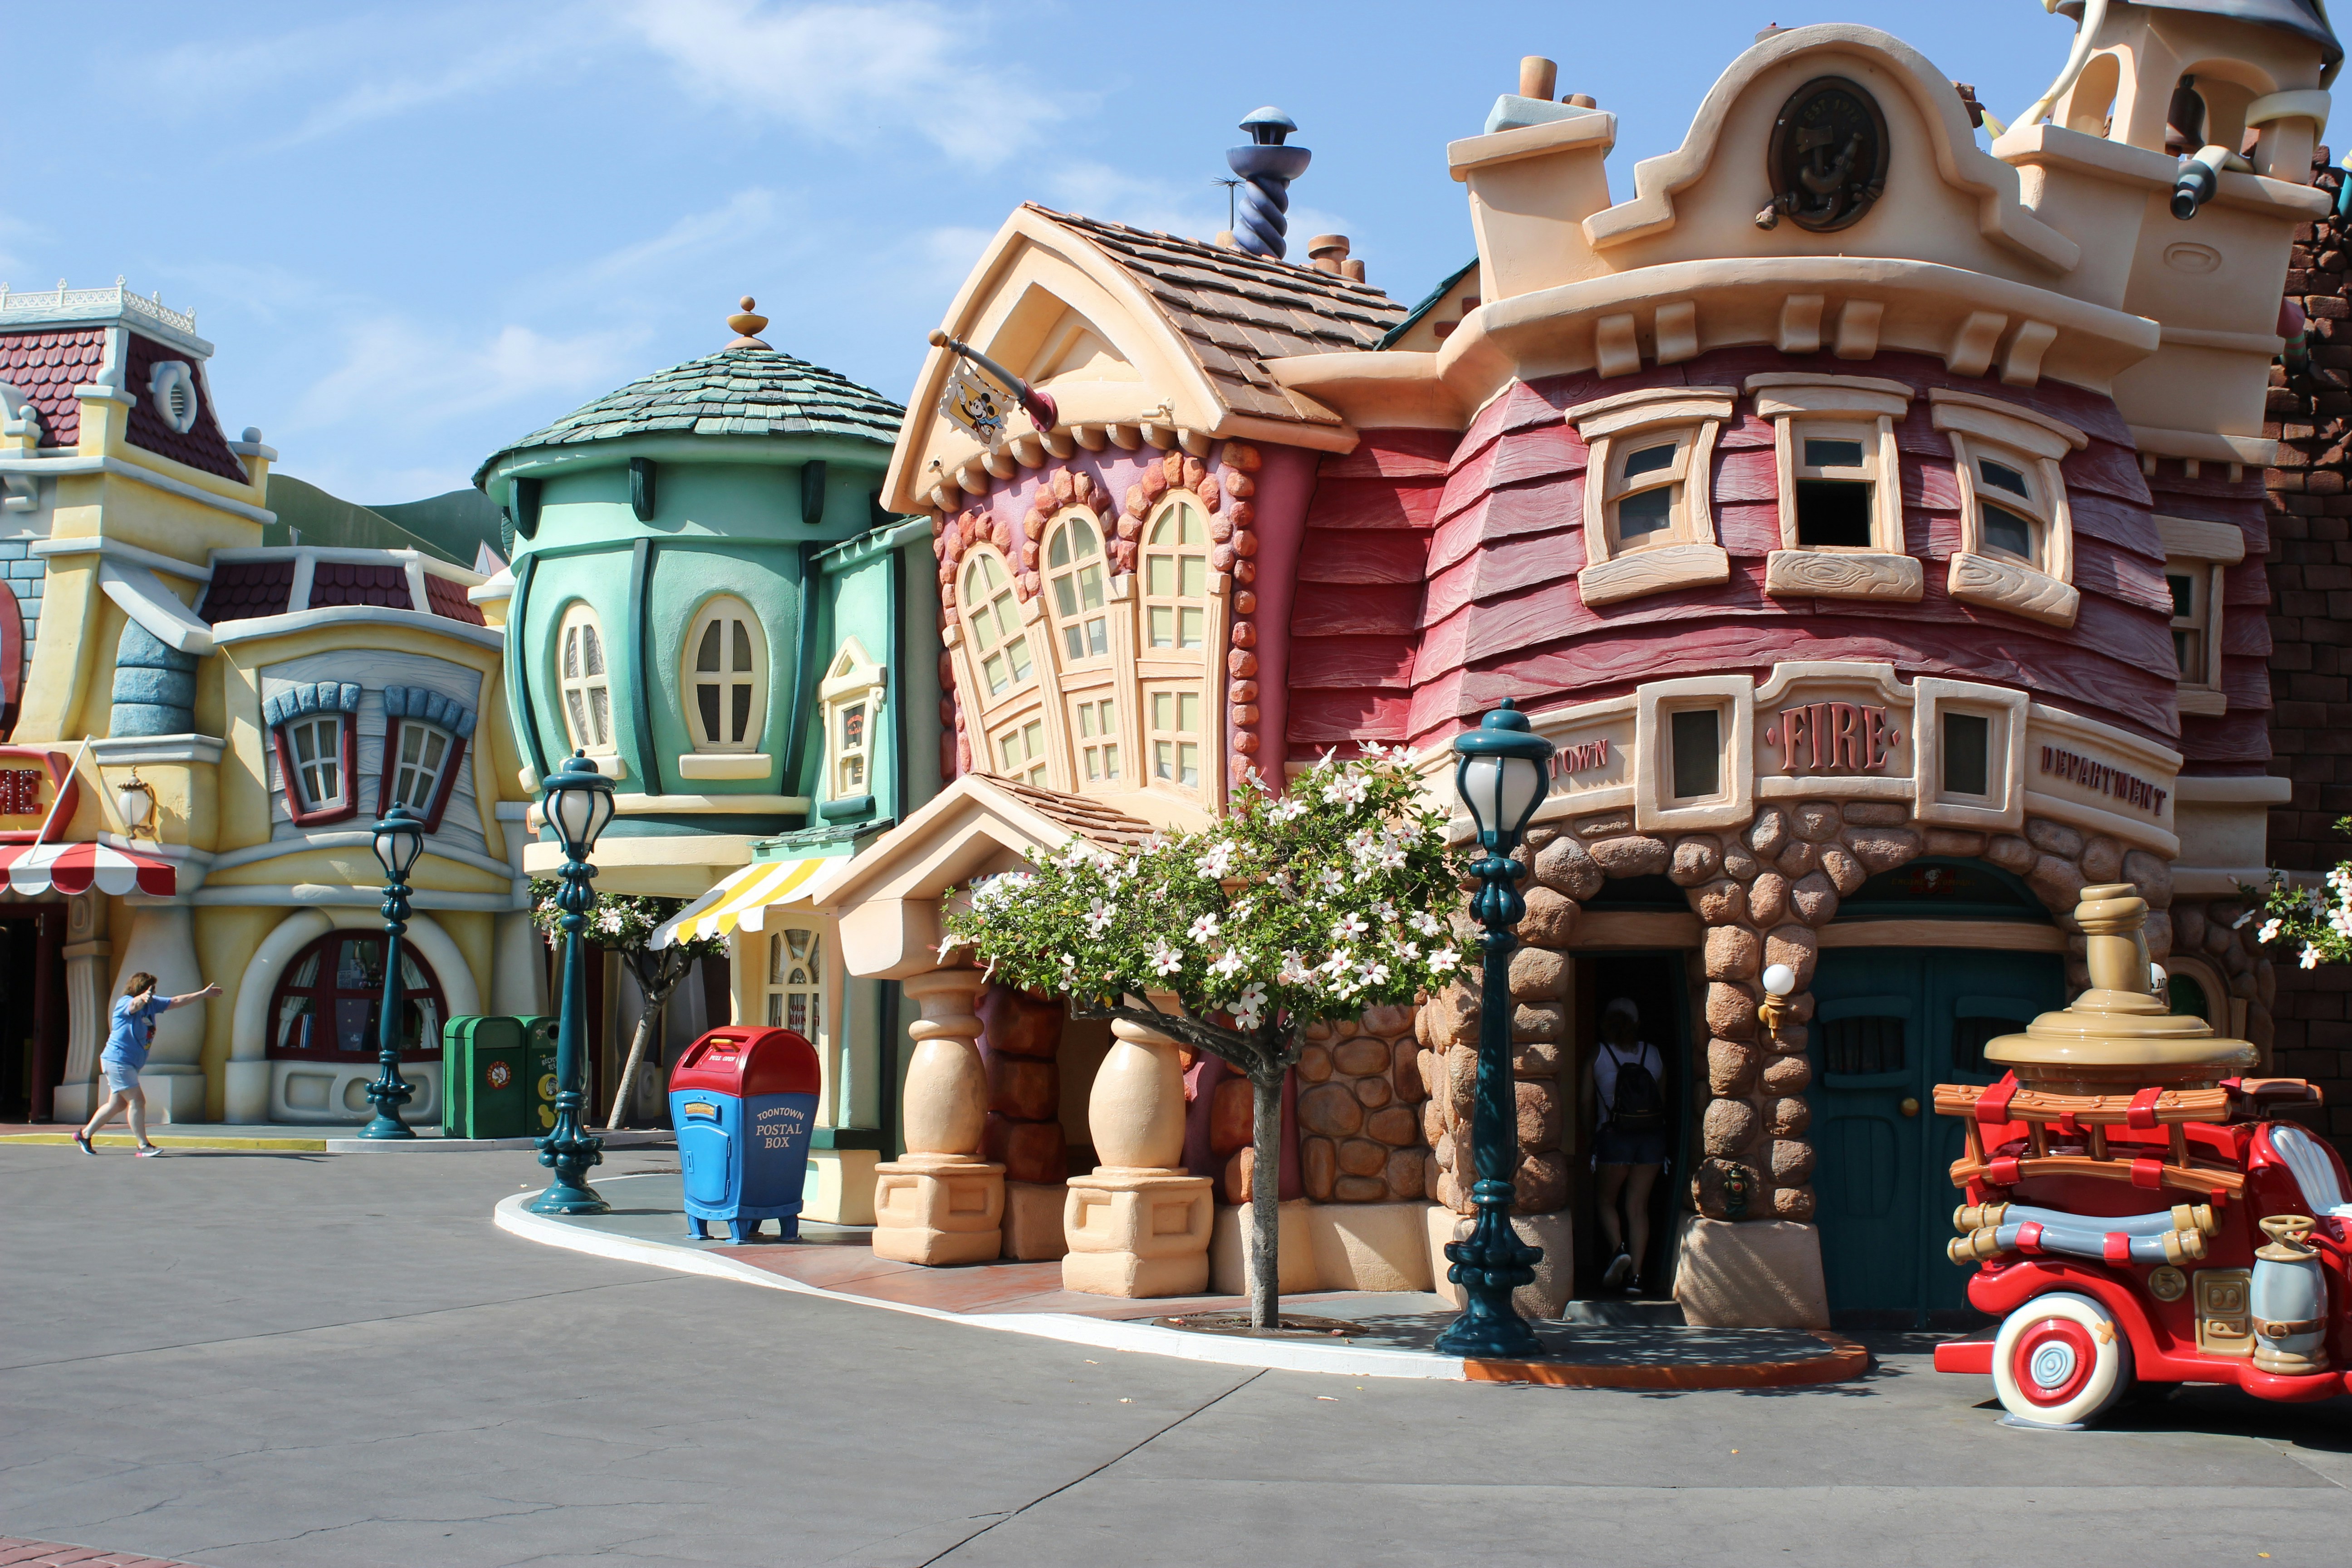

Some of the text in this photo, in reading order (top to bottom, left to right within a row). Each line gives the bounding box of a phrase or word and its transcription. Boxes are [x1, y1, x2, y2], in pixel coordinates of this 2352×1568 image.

[1780, 702, 1887, 770] FIRE
[2041, 745, 2167, 816] DEPARTMENT
[501, 1062, 511, 1080] CLEAN
[757, 1107, 805, 1121] TOONTOWN
[755, 1123, 803, 1136] POSTAL
[764, 1137, 790, 1149] BOX
[2157, 1273, 2176, 1297] 5
